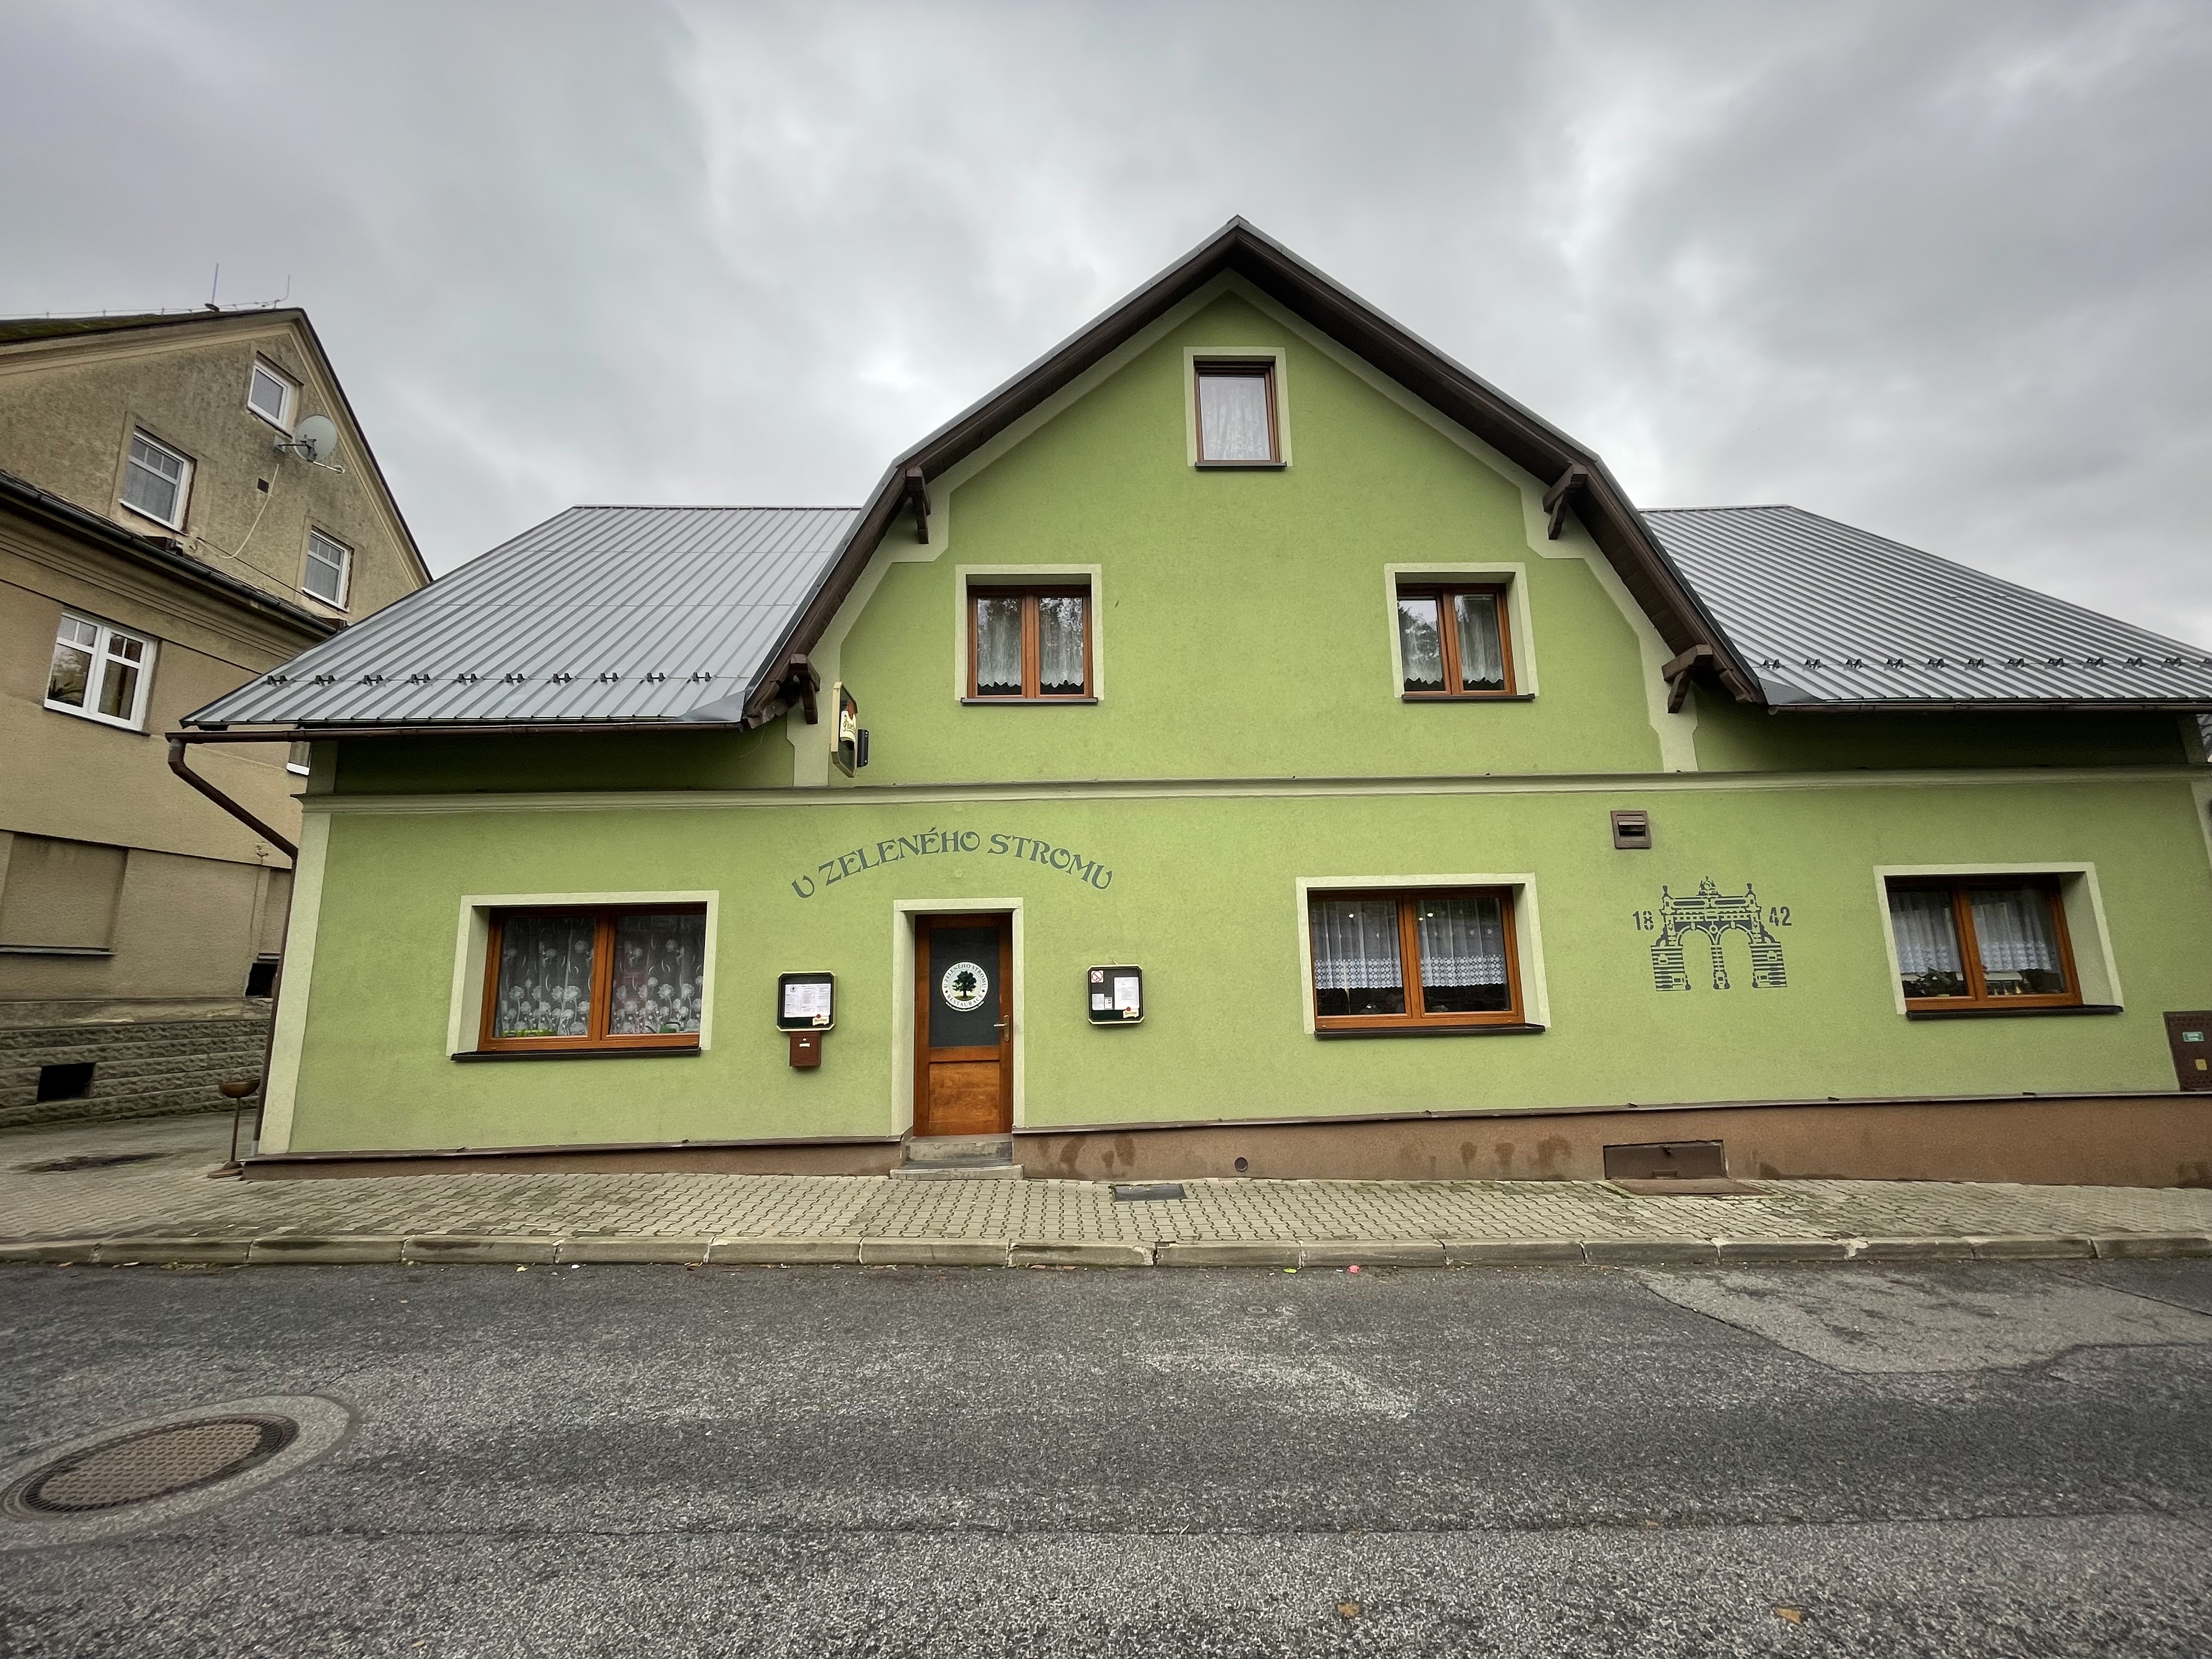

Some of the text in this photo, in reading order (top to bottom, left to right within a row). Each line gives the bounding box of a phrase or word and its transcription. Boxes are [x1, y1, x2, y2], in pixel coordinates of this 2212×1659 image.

[791, 827, 1112, 898] U ZELENÉHO STROMU
[1633, 906, 1792, 930] 18 42
[972, 966, 986, 988] STROMU
[947, 994, 983, 1007] RESTAURACE
